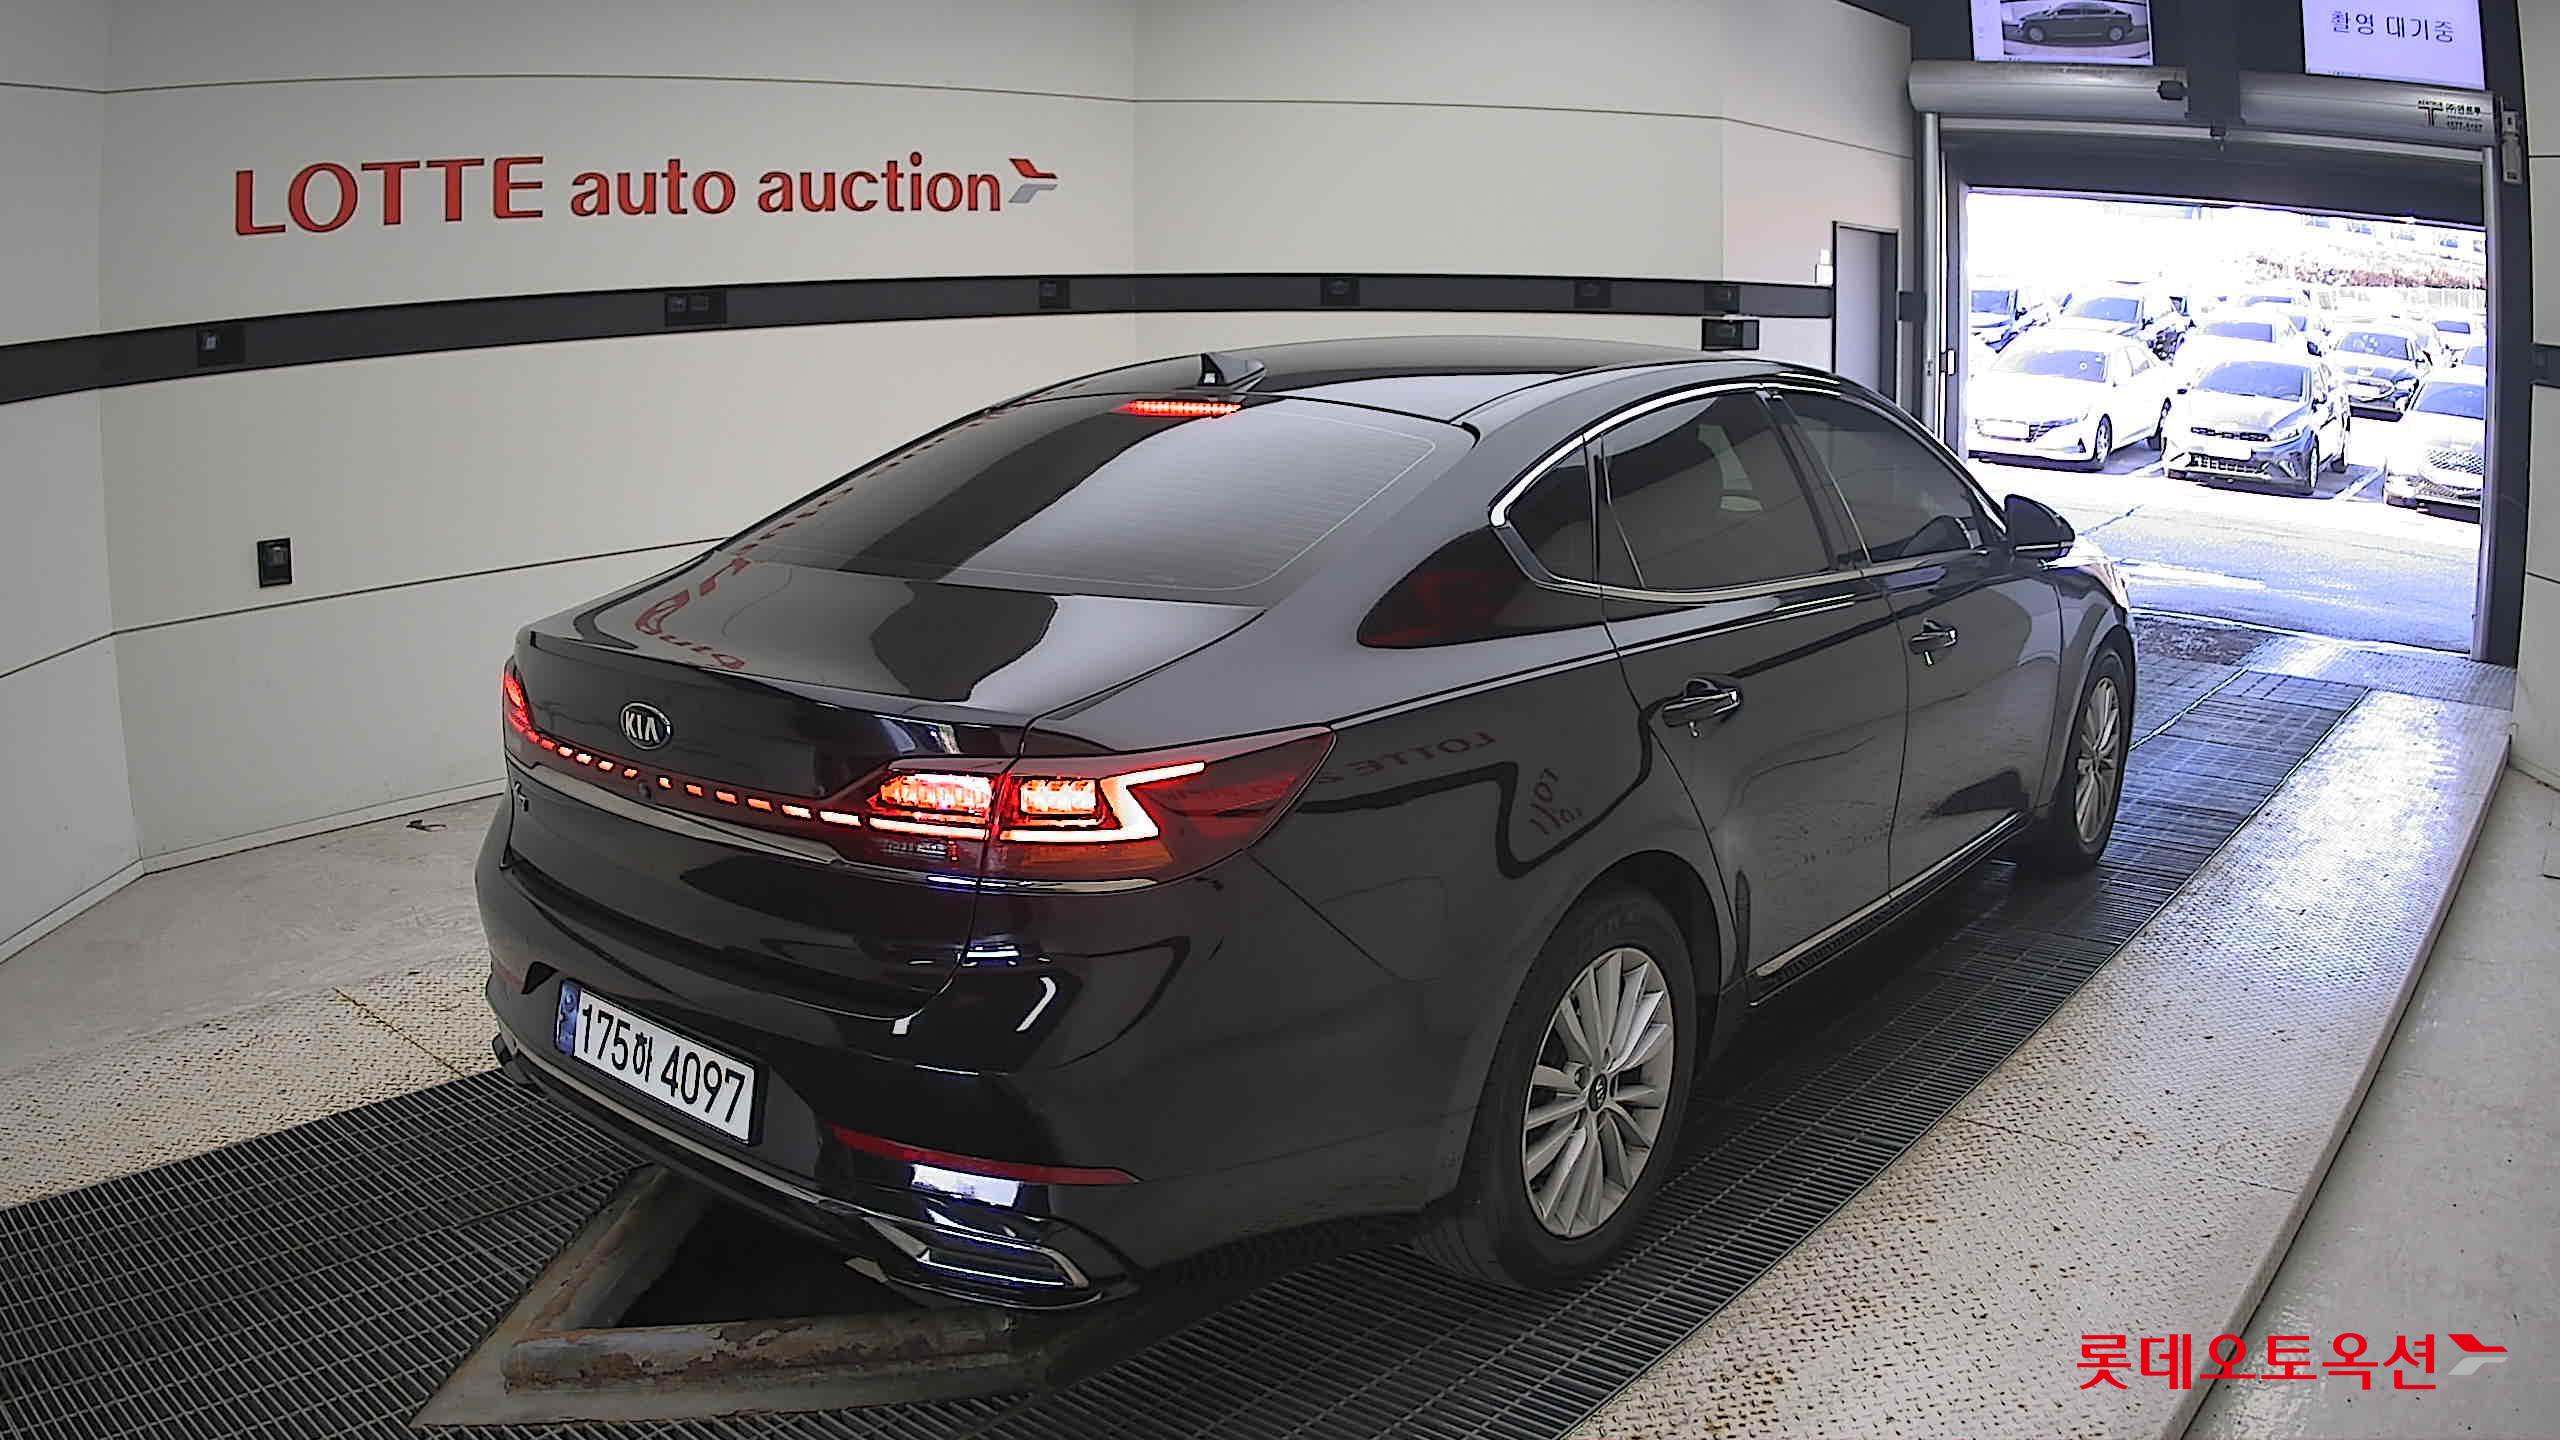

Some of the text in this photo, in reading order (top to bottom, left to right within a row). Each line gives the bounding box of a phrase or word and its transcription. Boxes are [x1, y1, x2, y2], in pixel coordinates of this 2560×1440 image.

[2332, 10, 2454, 43] 촬영 대기중
[235, 152, 1002, 235] LOTTE auto auction
[625, 710, 660, 743] KIA
[582, 1003, 746, 1123] 175하 4097
